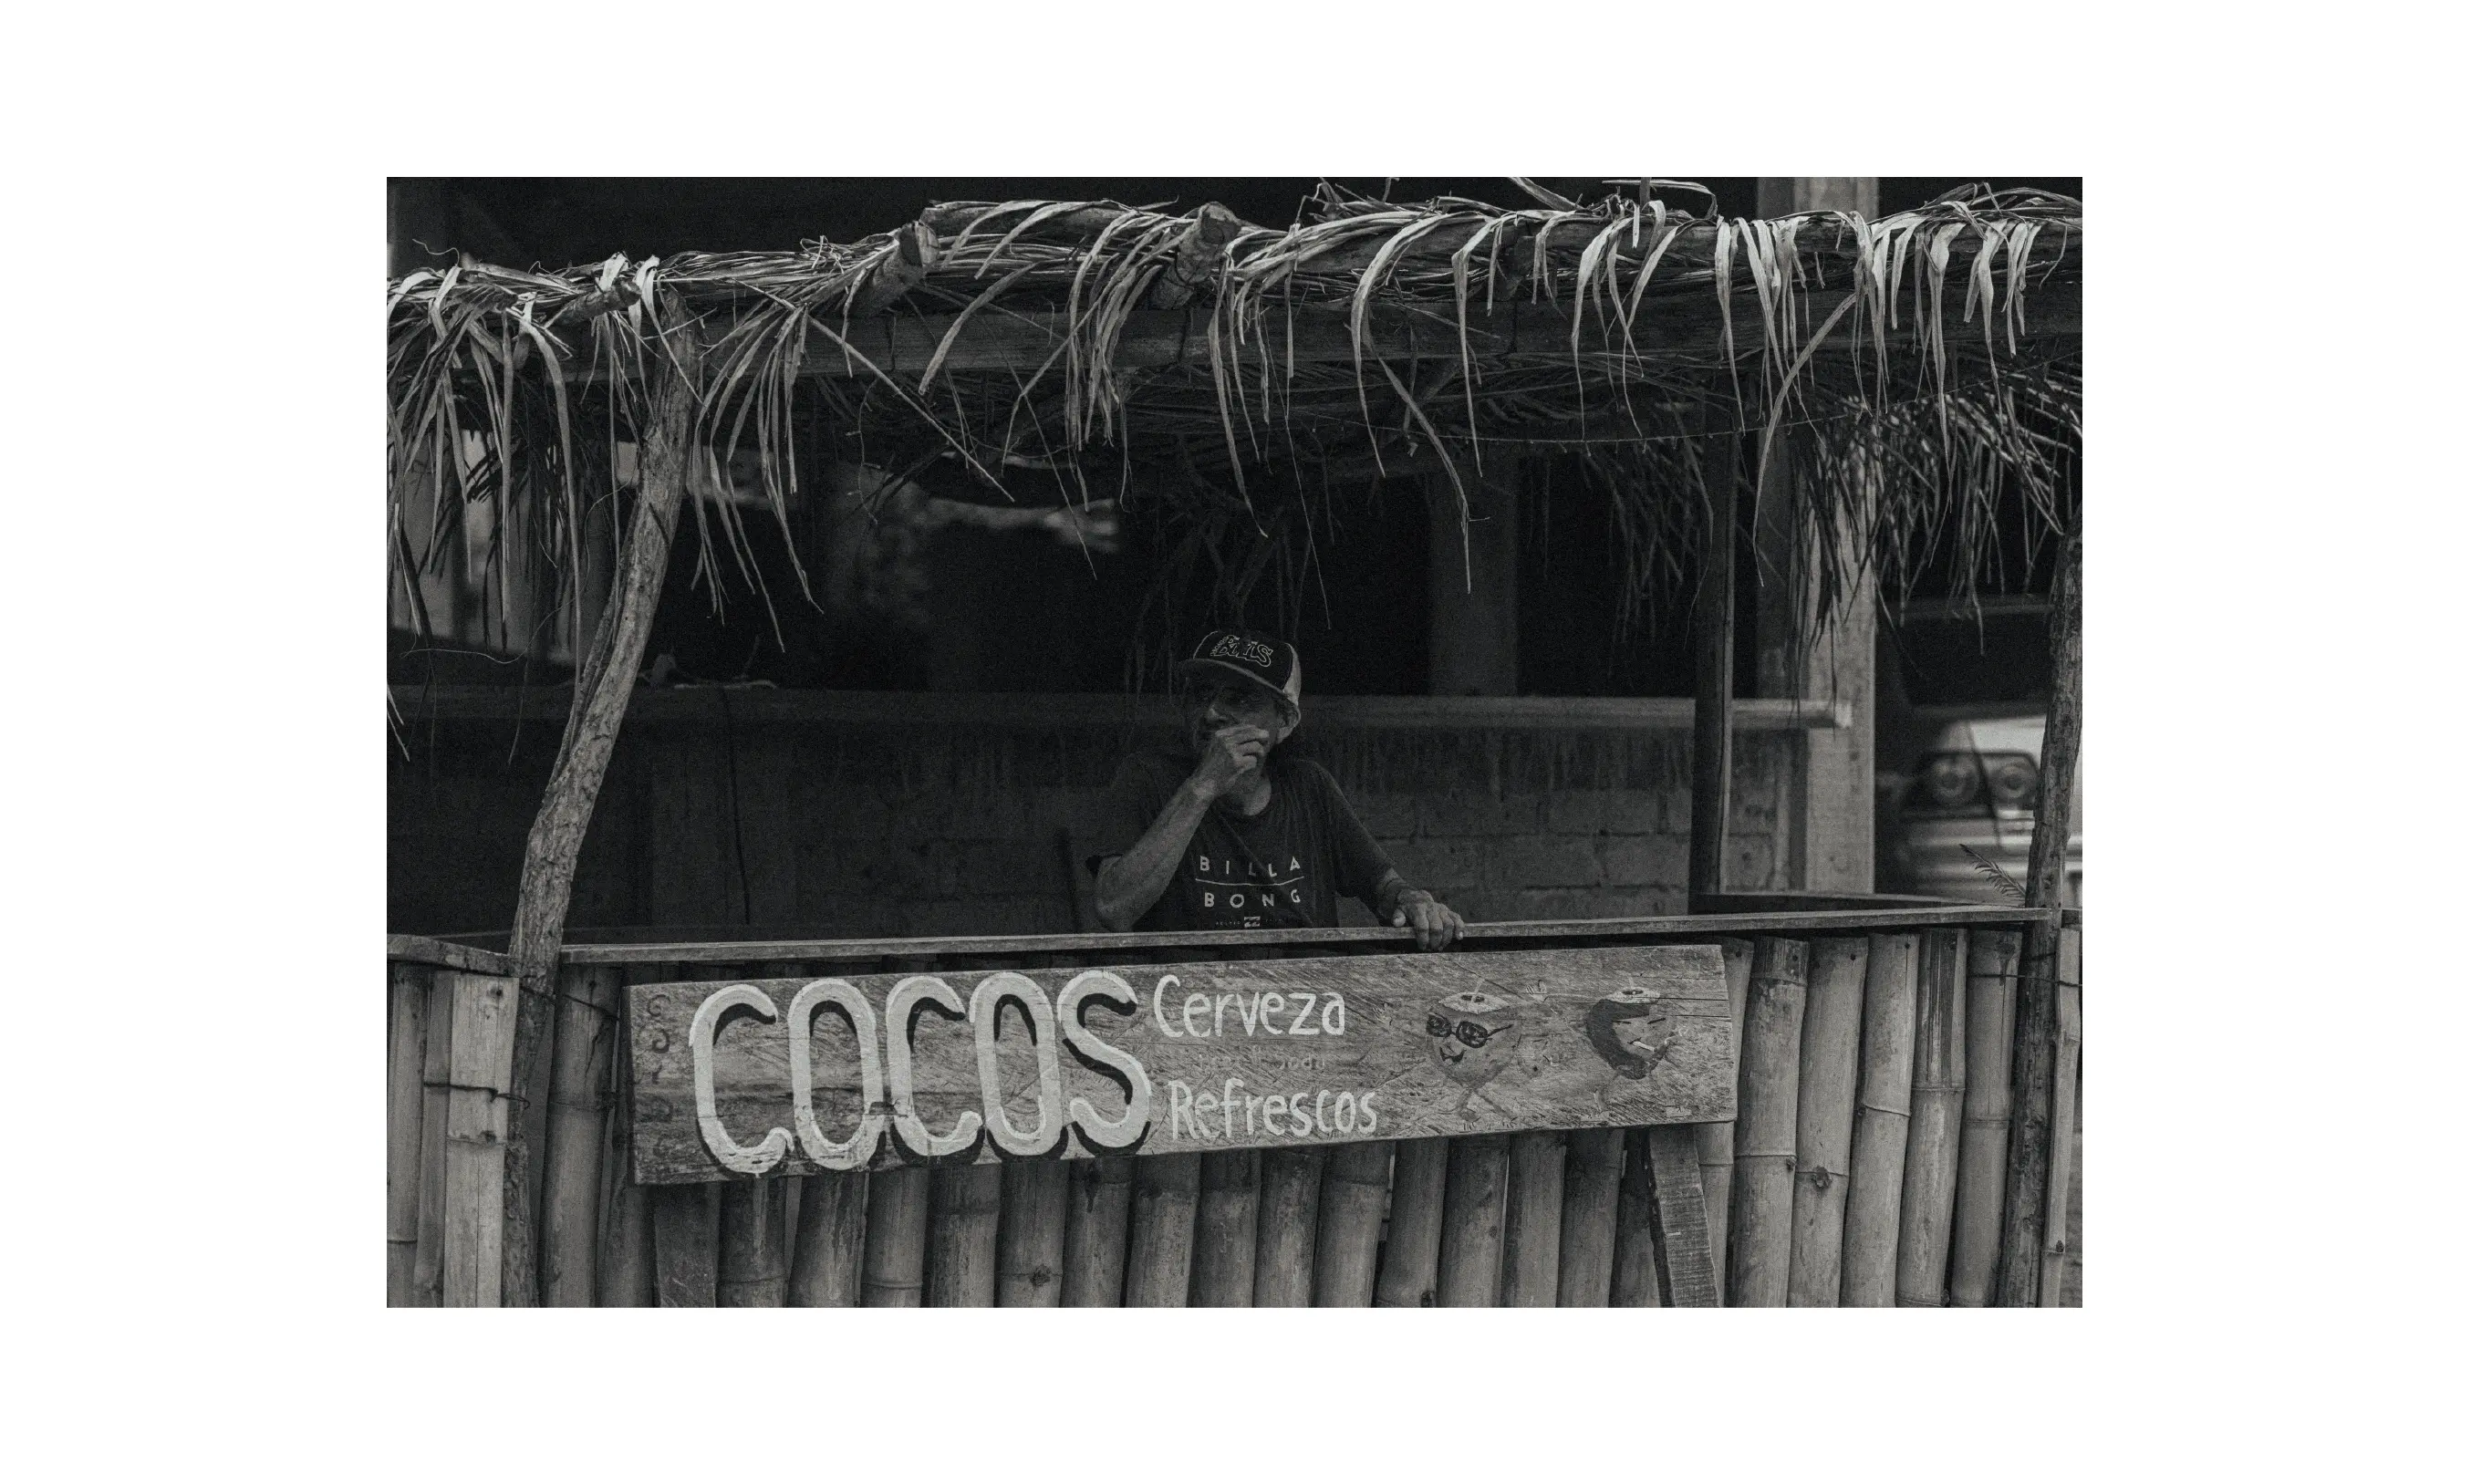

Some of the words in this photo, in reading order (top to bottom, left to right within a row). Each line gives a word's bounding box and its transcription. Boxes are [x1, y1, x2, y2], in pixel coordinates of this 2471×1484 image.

[1199, 855, 1302, 877] BILLA
[1203, 888, 1302, 909] BONG
[1153, 974, 1346, 1038] Cerveza
[689, 970, 1151, 1177] COCOS
[1170, 1076, 1377, 1140] Refrescos
